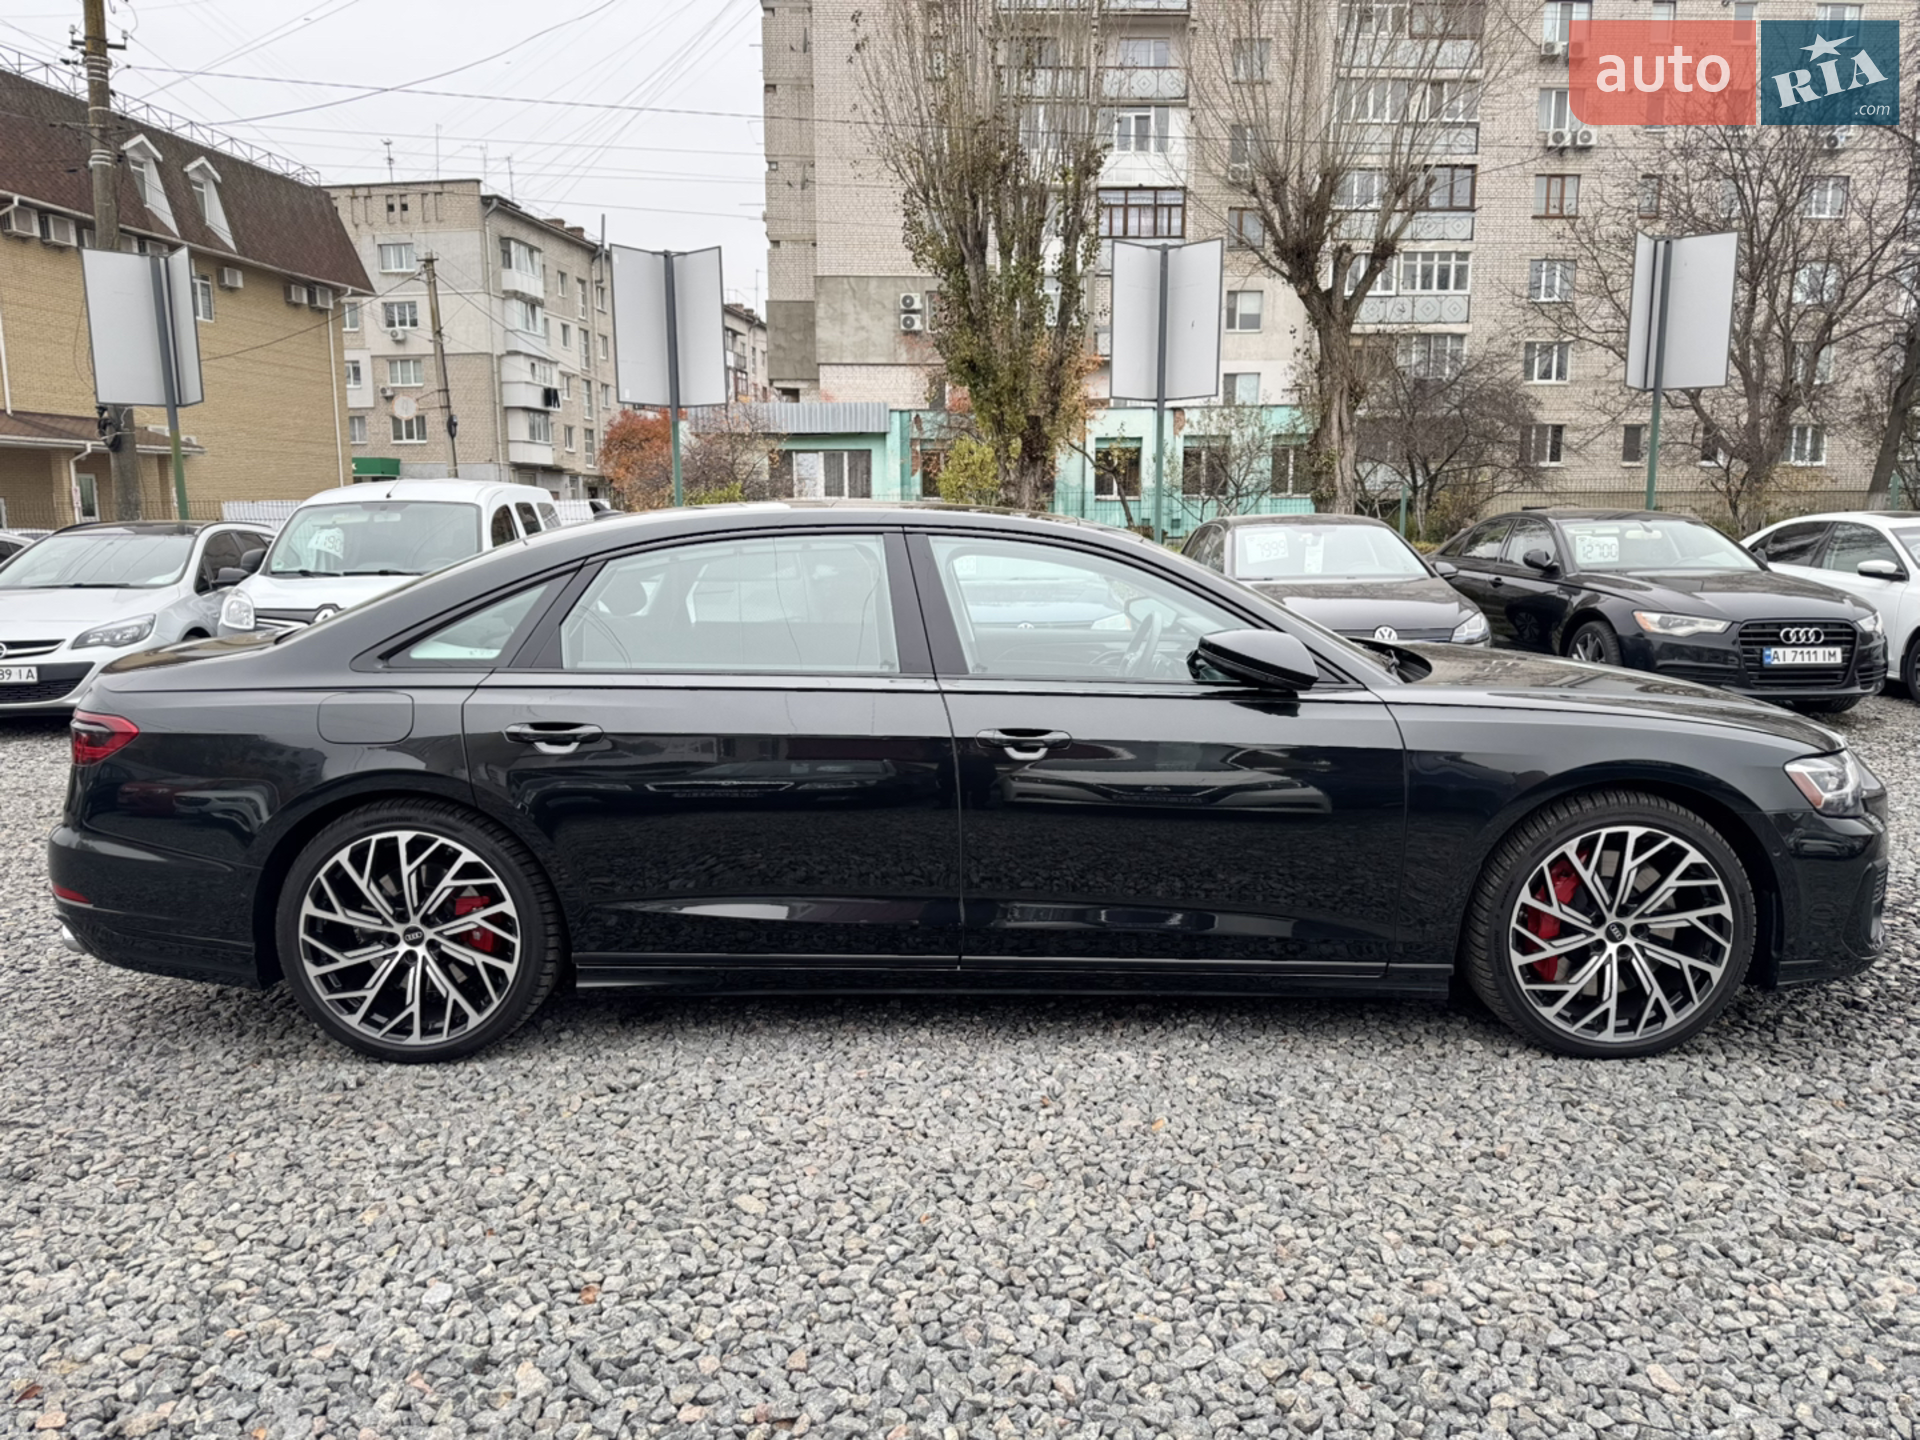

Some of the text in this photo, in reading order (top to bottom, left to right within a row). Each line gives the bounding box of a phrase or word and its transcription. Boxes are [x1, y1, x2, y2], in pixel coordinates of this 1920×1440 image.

[1256, 540, 1287, 557] 7999
[1582, 543, 1618, 559] 12700
[1772, 650, 1837, 662] AI 7111 IM
[18, 669, 35, 680] IA
